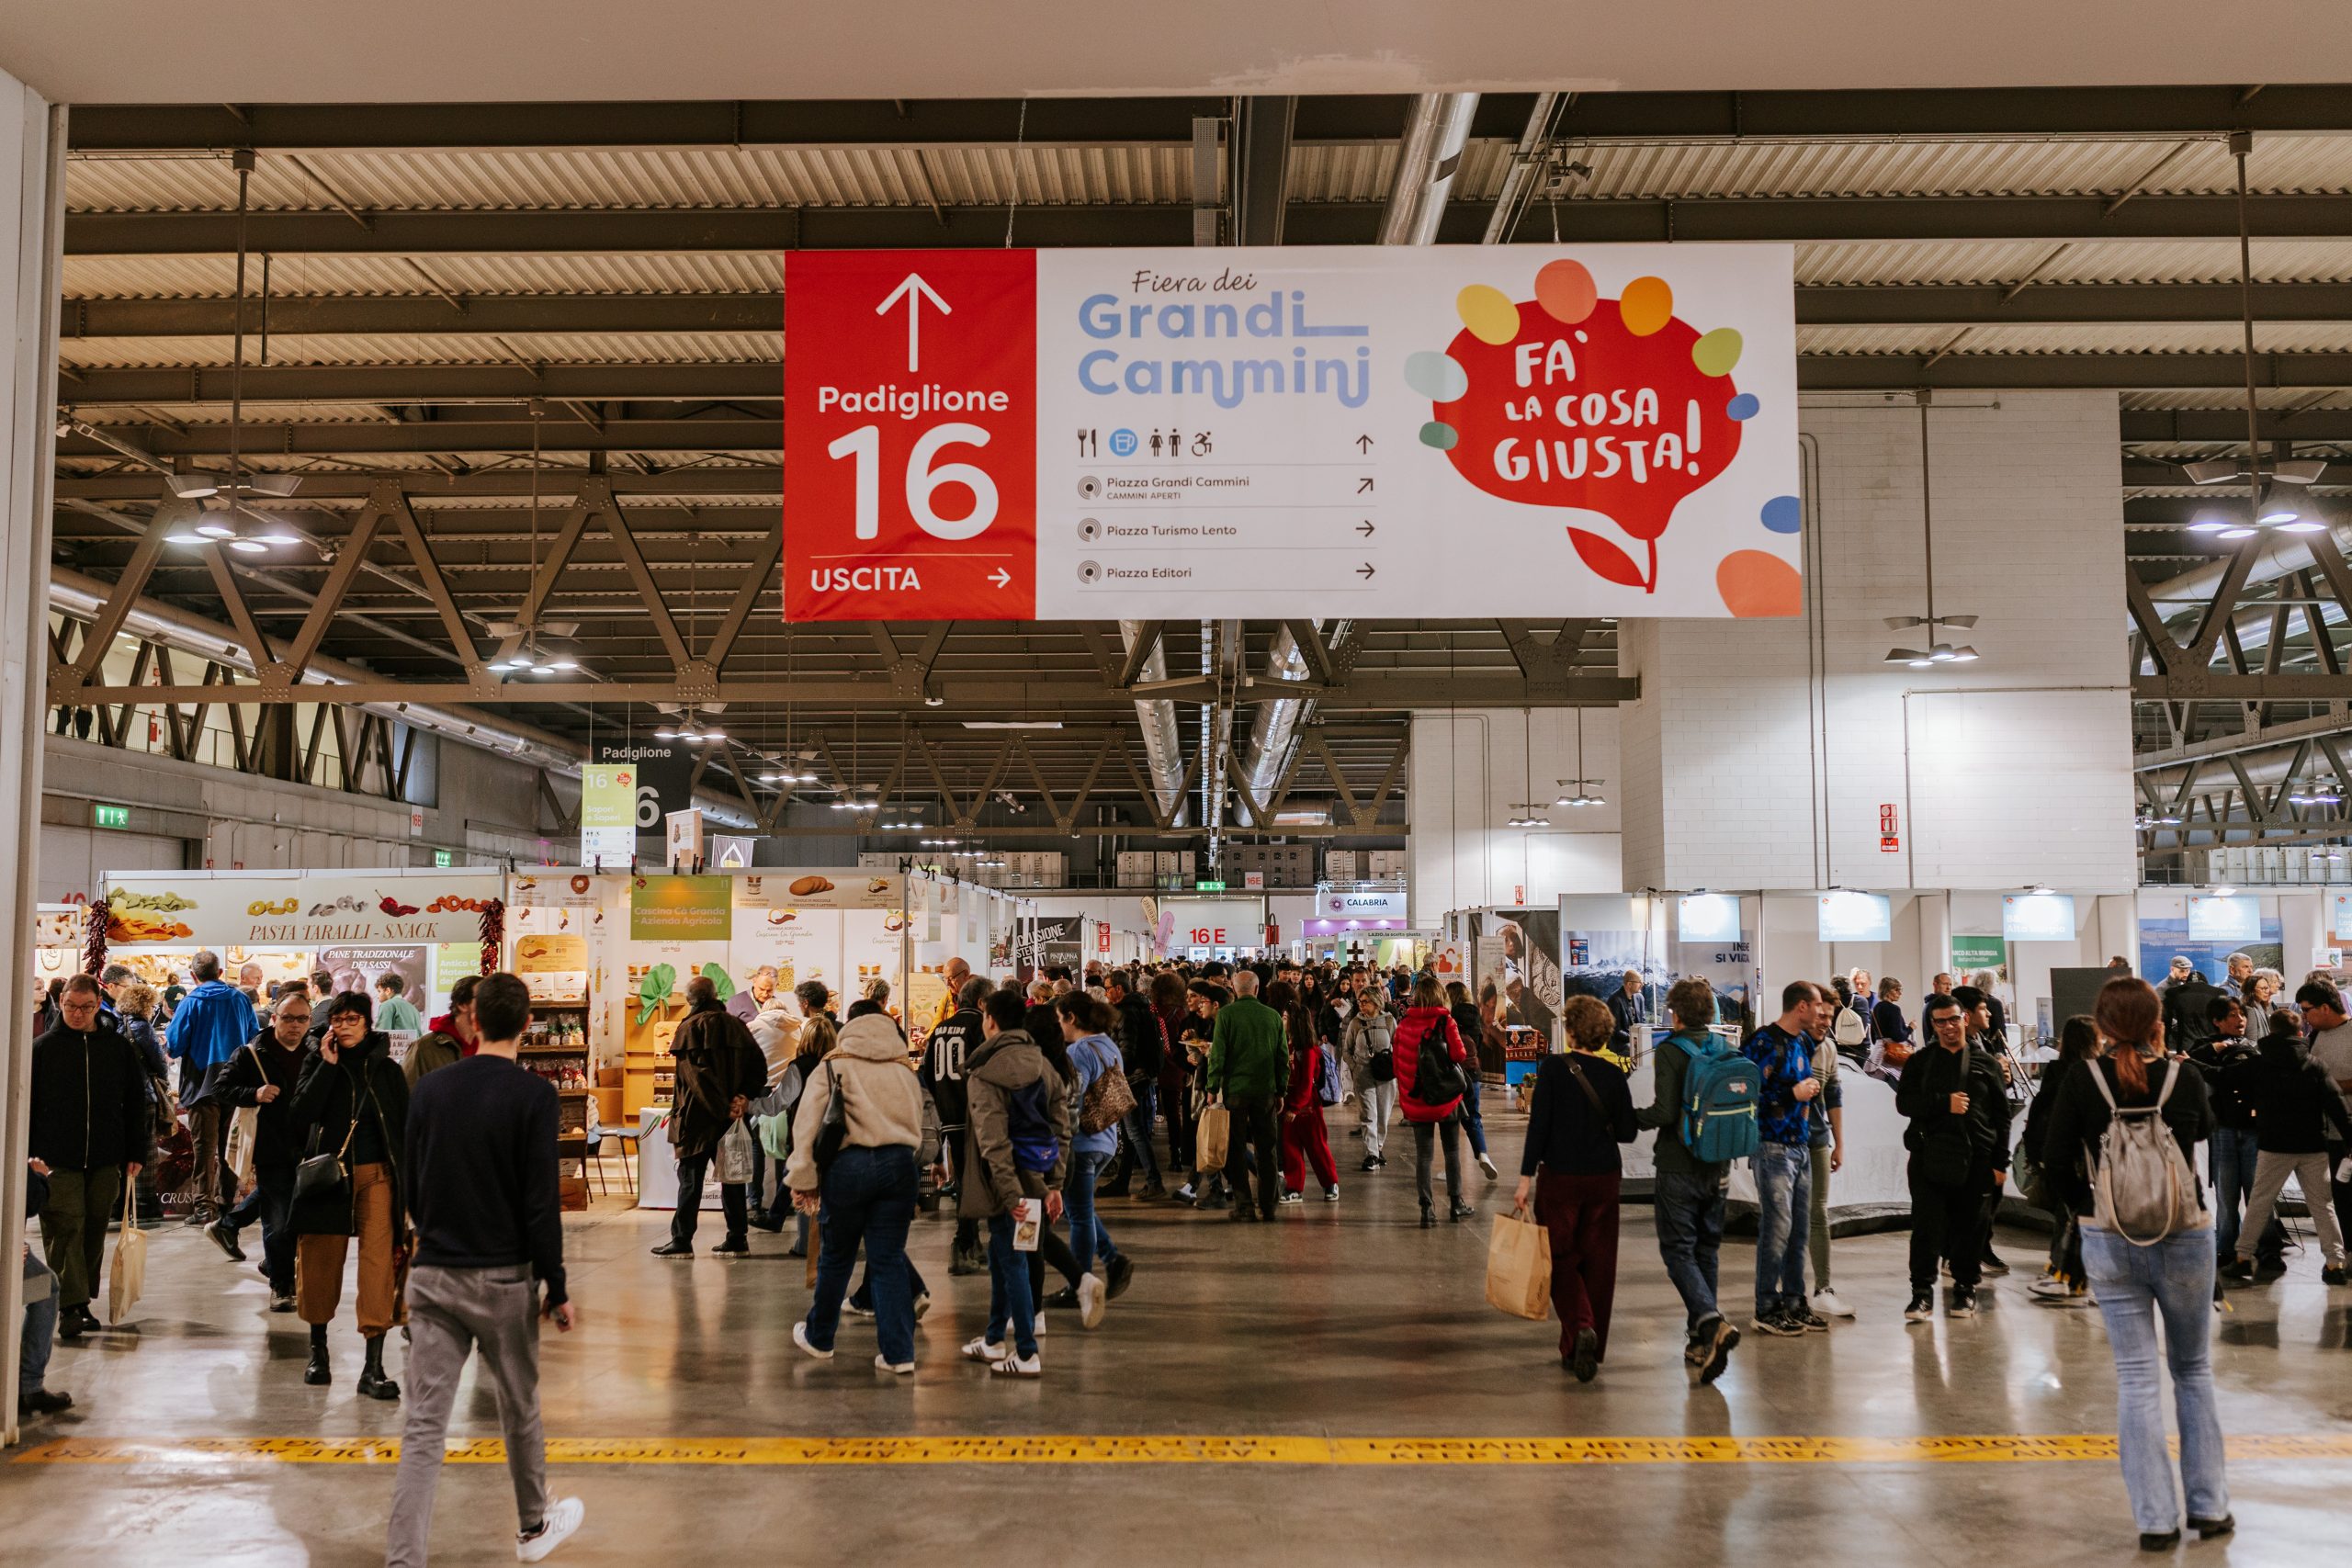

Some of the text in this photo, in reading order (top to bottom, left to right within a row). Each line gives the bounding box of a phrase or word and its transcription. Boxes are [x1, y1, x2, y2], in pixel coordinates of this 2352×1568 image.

[1132, 267, 1257, 294] Fiera dei
[1078, 290, 1369, 339] Grandi
[1078, 345, 1371, 410] Cammini
[819, 384, 1010, 420] Padiglione
[1504, 387, 1659, 428] LA COSA
[1493, 399, 1702, 484] GIUSTA!
[827, 423, 1000, 541] 16
[1106, 476, 1250, 488] Piazza Grandi Cammini
[1106, 491, 1182, 500] CAMMINI APERTI
[1106, 525, 1237, 536] Piazza Turismo Lento
[810, 566, 921, 592] USCITA
[1106, 567, 1192, 579] Piazza Editori
[602, 746, 672, 761] Padiglione
[587, 773, 607, 789] 16
[635, 785, 661, 828] 6
[594, 814, 620, 823] Saperi
[1246, 876, 1261, 886] 16E
[1347, 898, 1388, 907] CALABRIA
[634, 907, 673, 916] Cascina
[690, 907, 726, 916] Granda
[640, 917, 681, 925] Azienda
[683, 917, 723, 927] Agricola
[249, 925, 296, 941] PASTA
[302, 923, 371, 940] TARALLI
[383, 922, 439, 940] SNACK
[1189, 928, 1227, 944] 16 E
[328, 950, 415, 959] PANE TRADIZIONALE
[351, 961, 391, 970] DEI SASSI
[441, 959, 468, 967] Antico
[947, 1026, 967, 1035] KIDS
[934, 1036, 966, 1081] 00
[160, 1192, 192, 1204] CRUS
